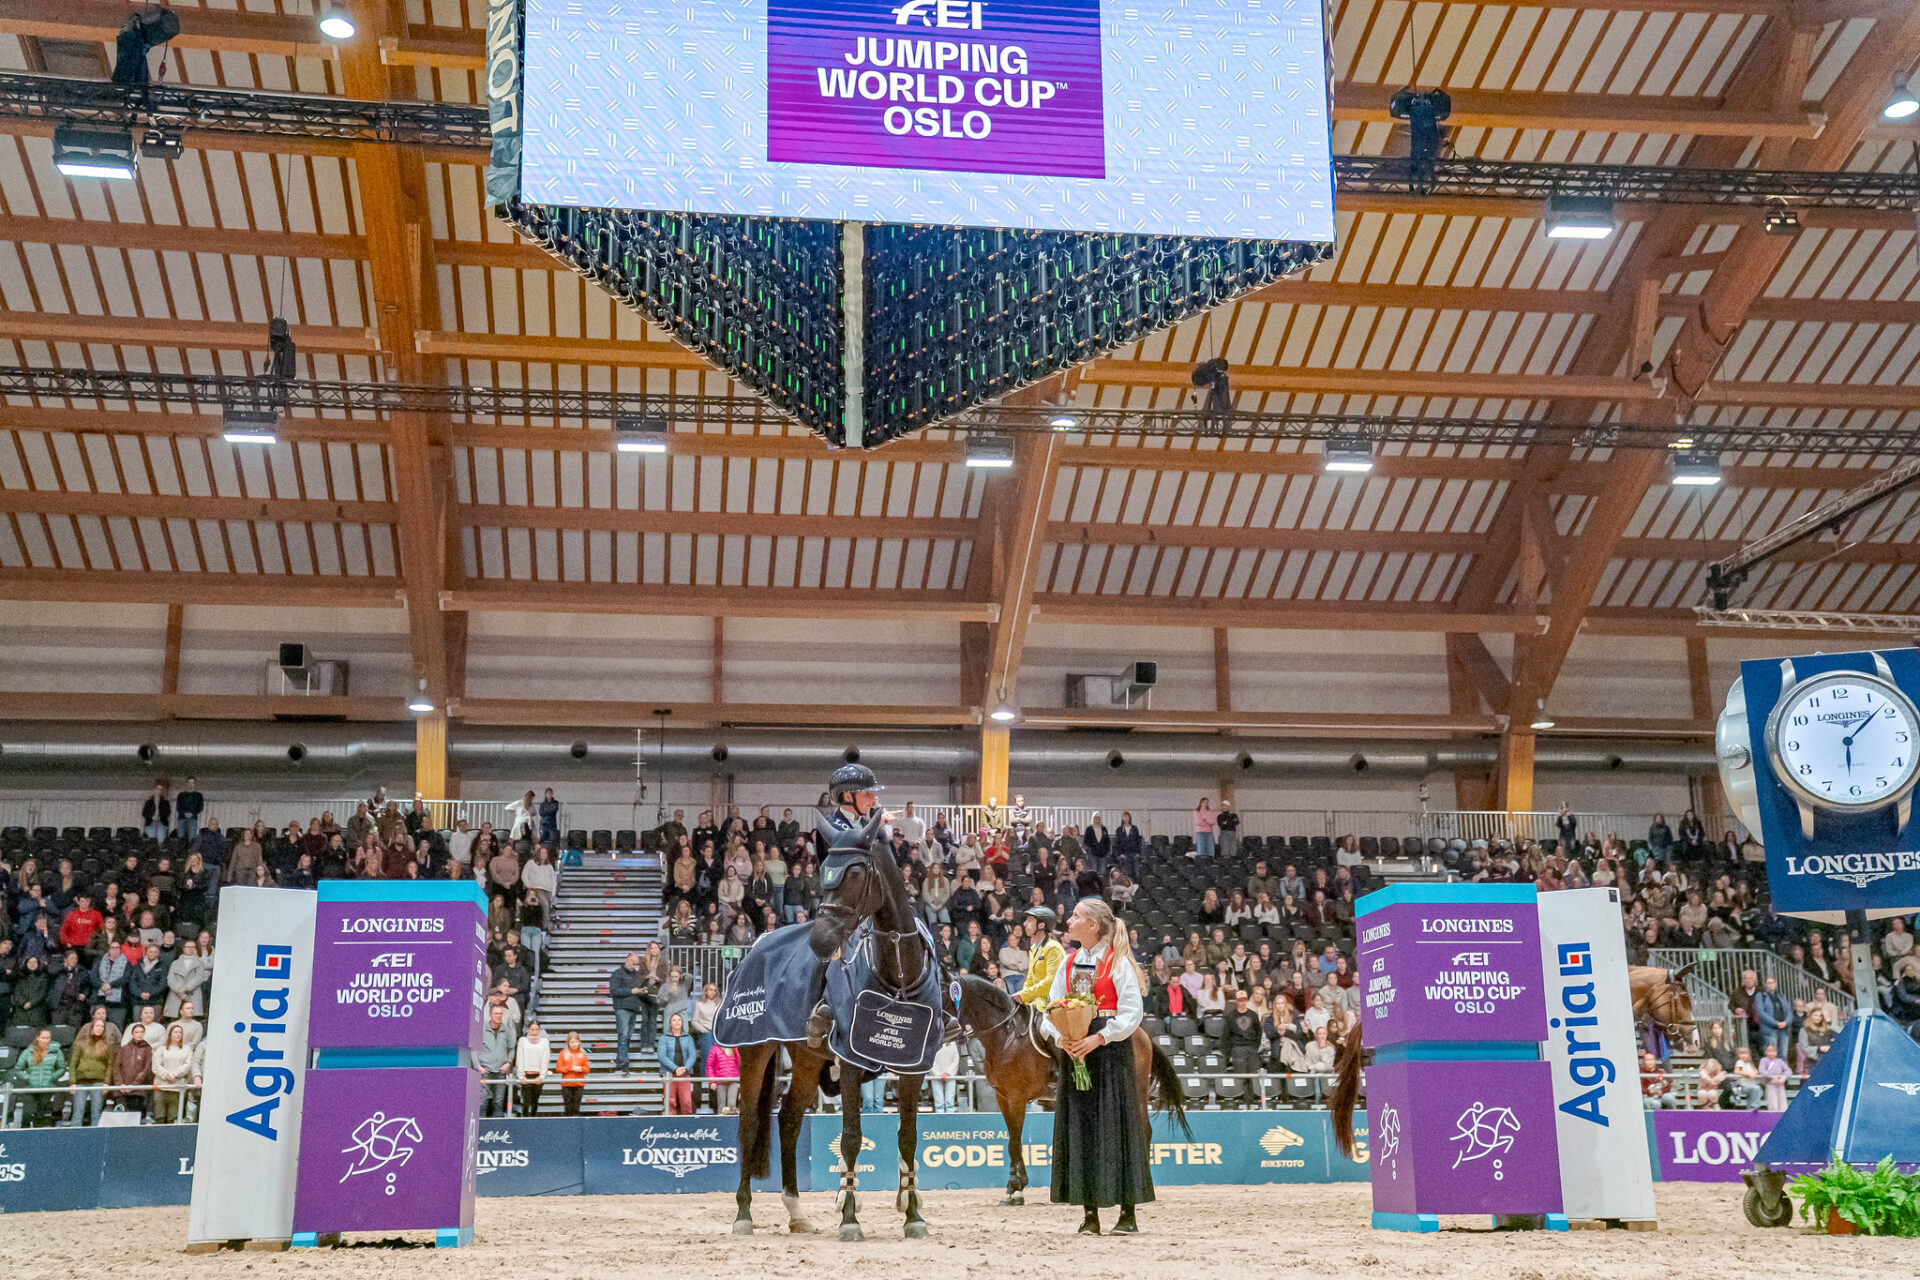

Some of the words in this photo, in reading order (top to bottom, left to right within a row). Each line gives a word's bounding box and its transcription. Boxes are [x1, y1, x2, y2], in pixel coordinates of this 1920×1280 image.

[844, 36, 1028, 75] JUMPING
[489, 0, 518, 134] LON
[817, 67, 965, 104] WORLD
[883, 105, 992, 139] OSLO
[1832, 688, 1848, 699] 12
[1866, 693, 1872, 703] 1
[1810, 697, 1820, 708] 11
[1817, 711, 1871, 721] LONGINES
[1884, 708, 1896, 718] 2
[1793, 715, 1809, 726] 10
[1895, 732, 1908, 743] 3
[1788, 741, 1800, 751] 9
[1890, 757, 1904, 767] 4
[1800, 764, 1812, 775] 8
[1822, 781, 1833, 791] 7
[1876, 777, 1887, 787] 5
[1849, 785, 1861, 796] 6
[833, 818, 849, 830] LO
[341, 918, 444, 933] LONGINES
[1421, 919, 1514, 933] LONGINES
[1362, 922, 1391, 944] LONGINES
[370, 953, 413, 967] FEI
[1451, 952, 1489, 966] FEI
[349, 973, 433, 988] JUMPING
[1368, 974, 1392, 993] JUMPING
[1435, 971, 1510, 985] JUMPING
[336, 989, 403, 1004] WORLD
[1365, 991, 1384, 1008] WORLD
[1424, 986, 1485, 1000] WORLD
[367, 1004, 413, 1018] OSLO
[725, 1000, 766, 1020] LONGIN
[1375, 1005, 1388, 1019] OSLO
[1454, 1001, 1495, 1014] OSLO
[876, 1010, 912, 1023] LONGINES
[869, 1036, 892, 1047] WORLD
[874, 1033, 903, 1043] JUMPING
[1550, 982, 1616, 1127] Agria
[226, 987, 295, 1141] Agria
[922, 1130, 970, 1141] SAMMEN
[973, 1131, 994, 1140] FOR
[996, 1130, 1010, 1140] AL
[1352, 1142, 1370, 1164] G
[1669, 1131, 1771, 1165] LON
[476, 1150, 529, 1167] INES
[622, 1147, 738, 1165] LONGINES
[922, 1144, 1004, 1168] GODE
[1149, 1143, 1223, 1165] FTER
[178, 1157, 194, 1175] L
[1260, 1160, 1305, 1168] RIKSTOTO
